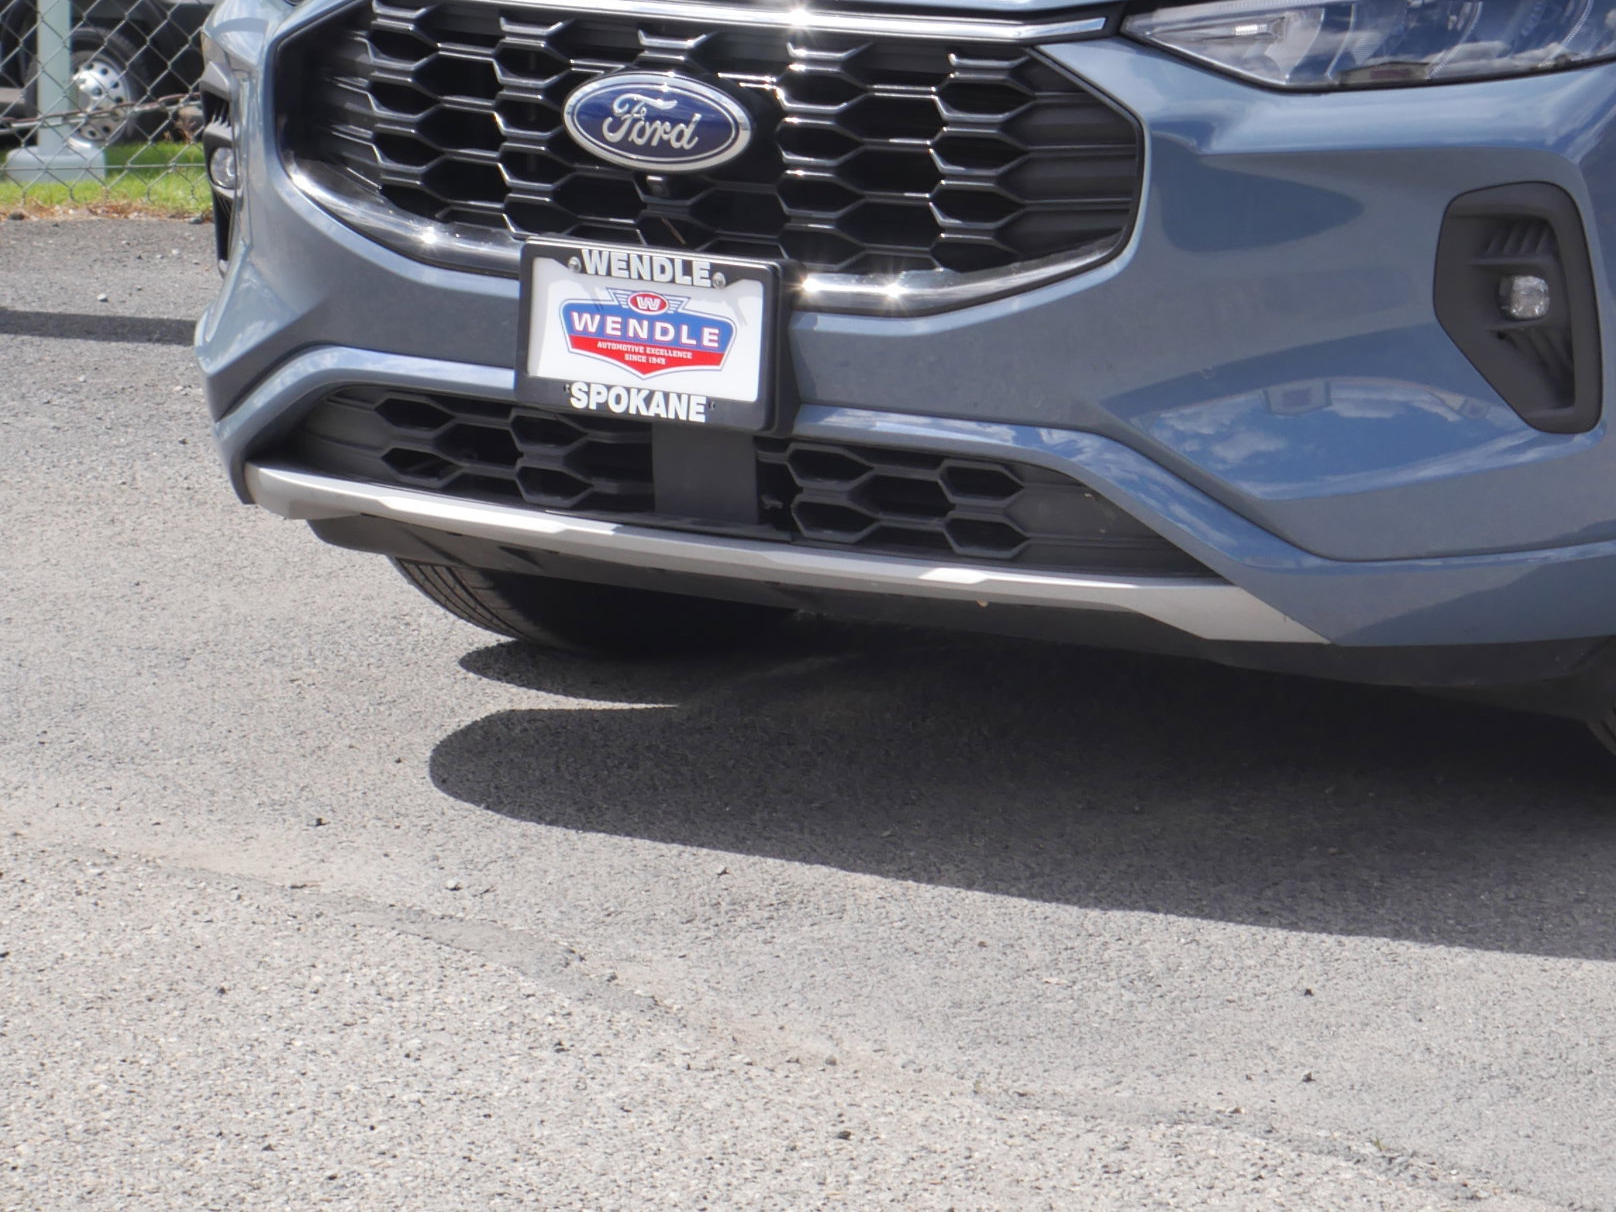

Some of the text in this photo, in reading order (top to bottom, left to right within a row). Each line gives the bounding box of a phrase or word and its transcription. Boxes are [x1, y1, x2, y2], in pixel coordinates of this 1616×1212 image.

[602, 93, 702, 150] Ford
[582, 249, 712, 288] WENDLE
[571, 311, 720, 347] WENDLE
[597, 341, 692, 359] AUTOMOTIVE EXCELLENCE
[624, 353, 647, 362] SINCE
[570, 381, 707, 423] SPOKANE
